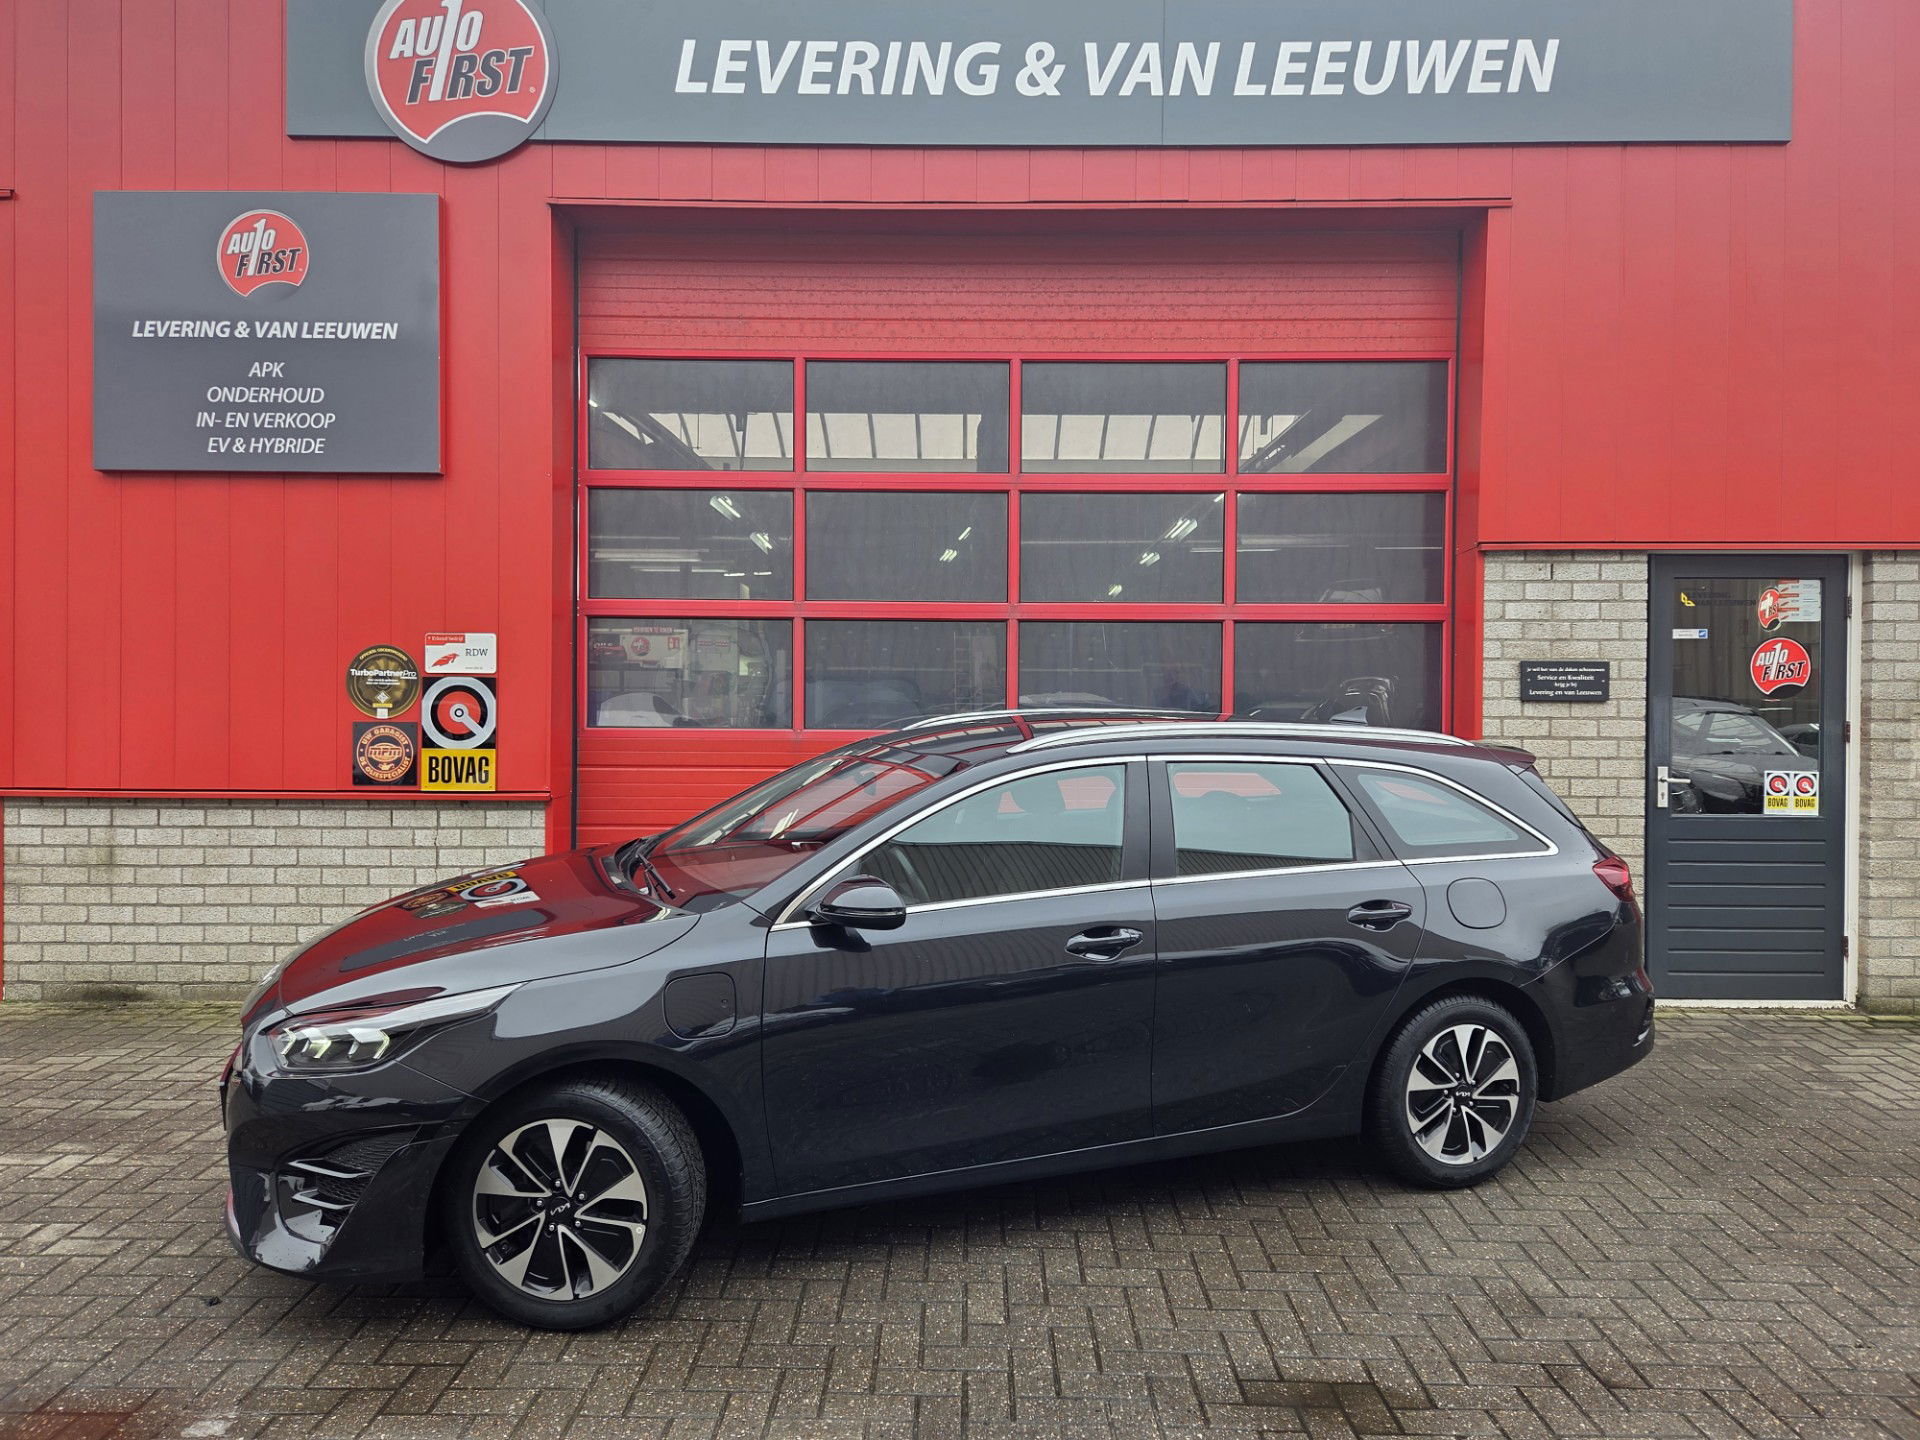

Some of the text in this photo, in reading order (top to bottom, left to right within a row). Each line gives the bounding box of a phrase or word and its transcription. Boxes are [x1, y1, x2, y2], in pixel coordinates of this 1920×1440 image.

[675, 39, 1559, 97] LEVERING & VAN LEEUWEN
[132, 320, 399, 340] LEVERING & VAN LEEUWEN
[248, 361, 286, 378] APK
[206, 386, 325, 404] ONDERHOUD
[196, 411, 336, 429] IN- EN VERKOOP
[207, 437, 326, 454] EV & HYBRIDE
[465, 648, 488, 657] RDW
[1529, 689, 1555, 697] Levering
[428, 756, 489, 784] BOVAG
[1768, 798, 1788, 807] BOVAG
[1795, 798, 1815, 808] BOVAG
